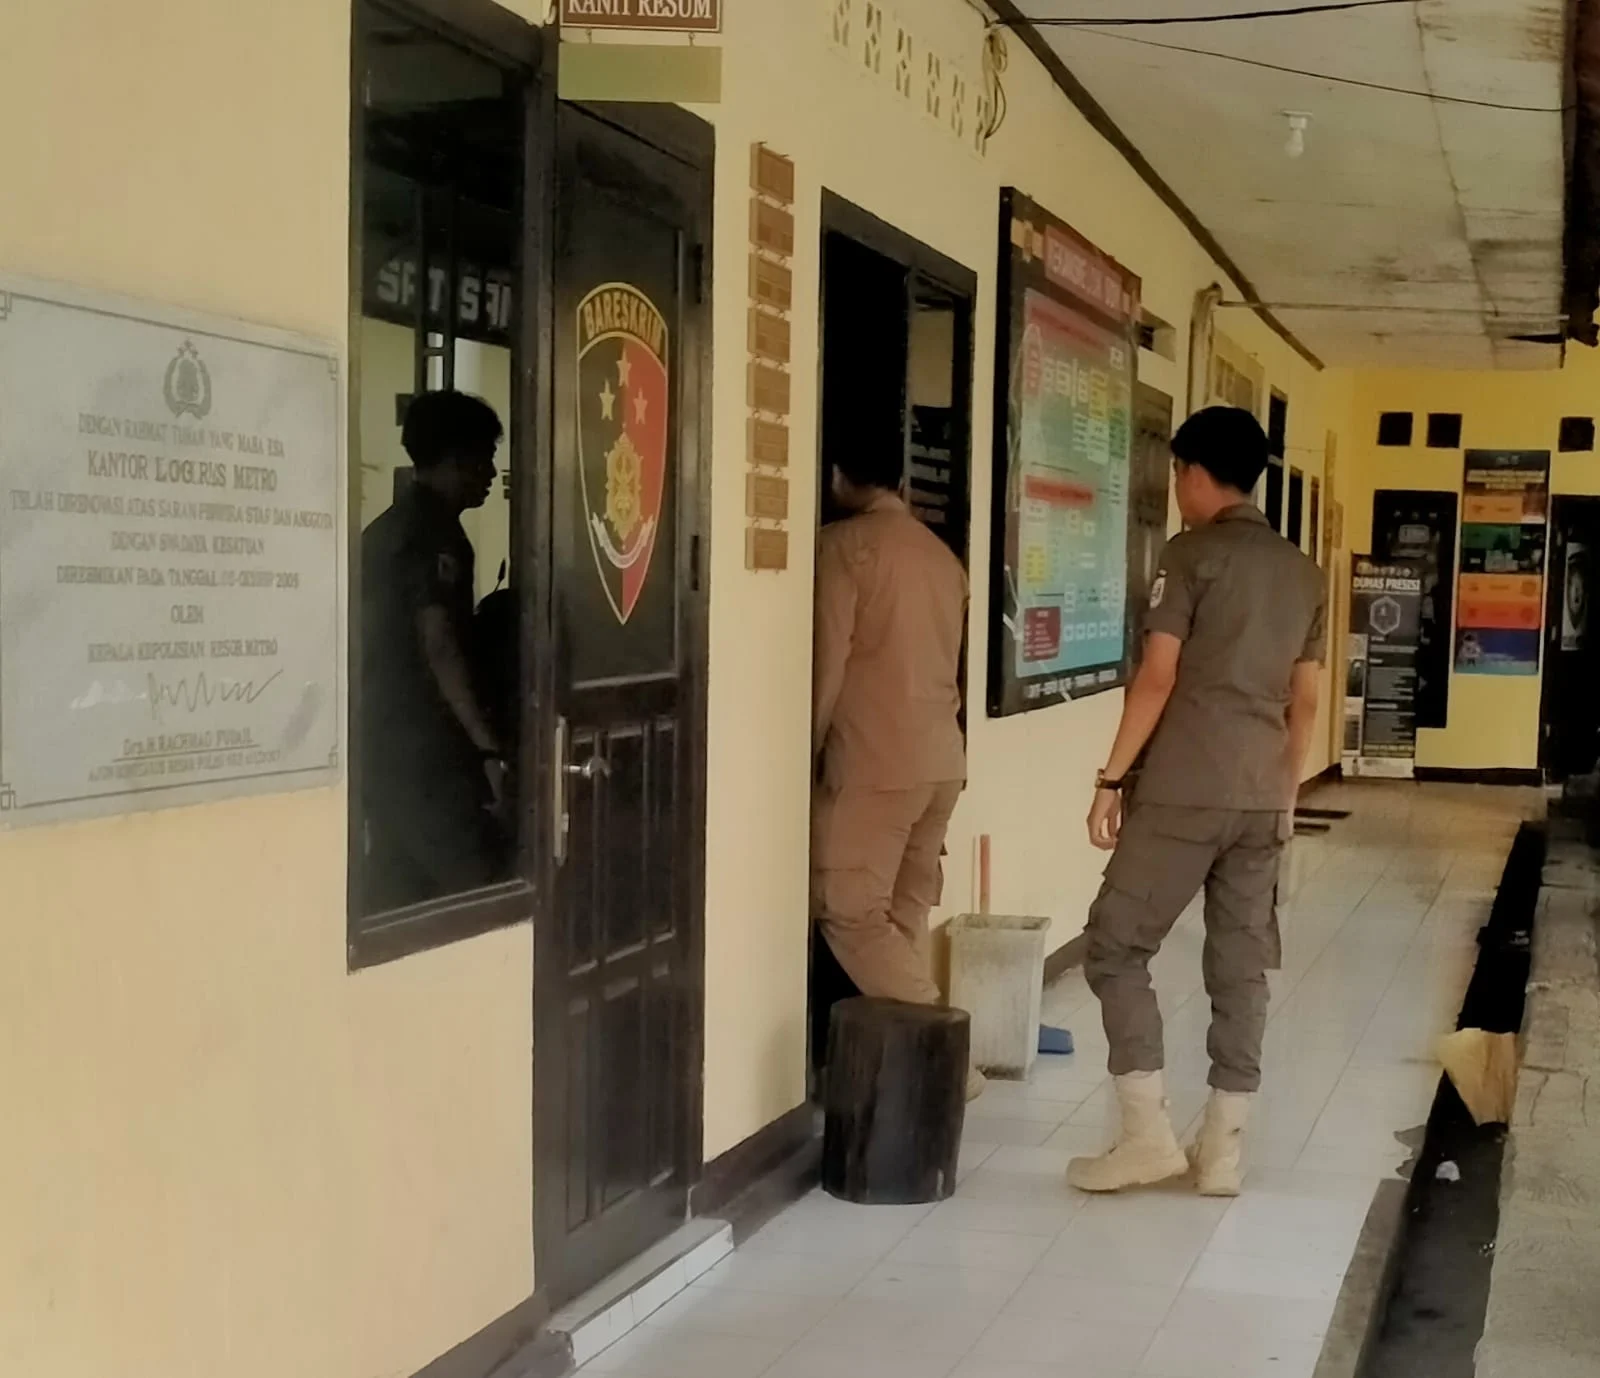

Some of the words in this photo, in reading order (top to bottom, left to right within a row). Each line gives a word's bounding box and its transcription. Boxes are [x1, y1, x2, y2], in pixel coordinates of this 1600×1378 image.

[636, 0, 713, 19] RESUM
[583, 290, 662, 355] BARESKRIM
[87, 449, 148, 480] KANTOR
[232, 464, 278, 492] METRO
